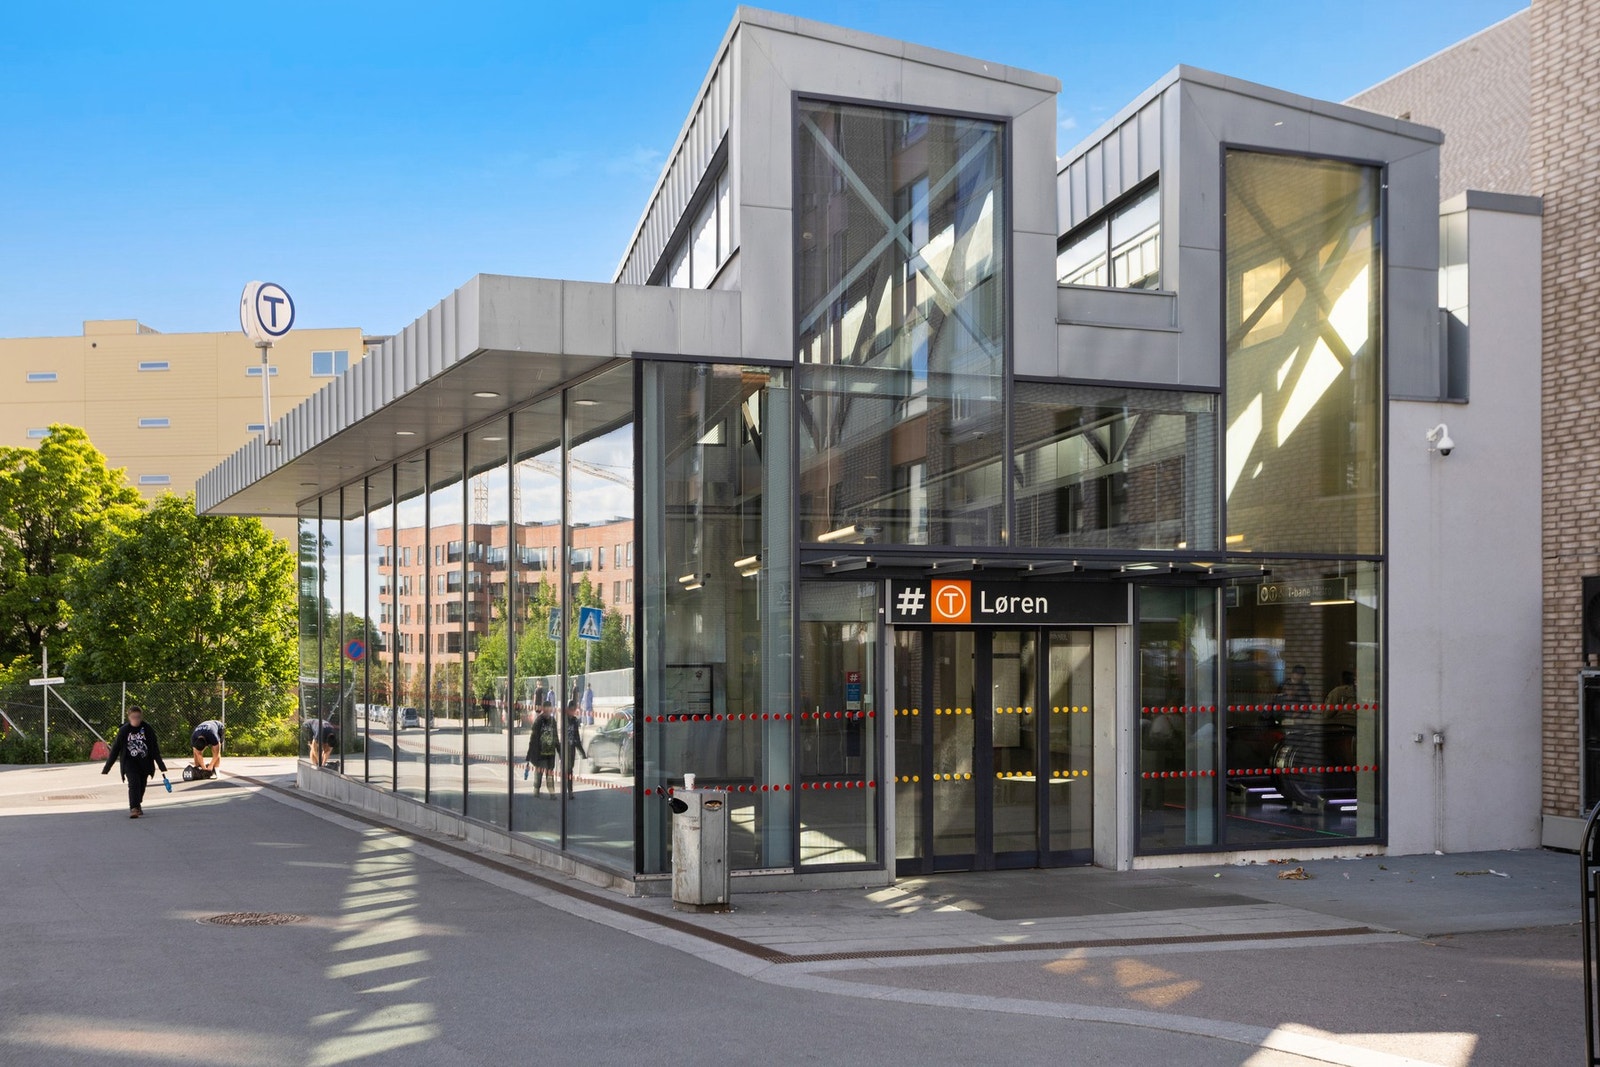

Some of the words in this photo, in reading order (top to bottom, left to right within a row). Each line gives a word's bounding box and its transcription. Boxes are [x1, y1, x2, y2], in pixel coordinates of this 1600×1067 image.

[263, 295, 285, 328] T
[943, 593, 959, 614] T
[981, 590, 1048, 614] Løren
